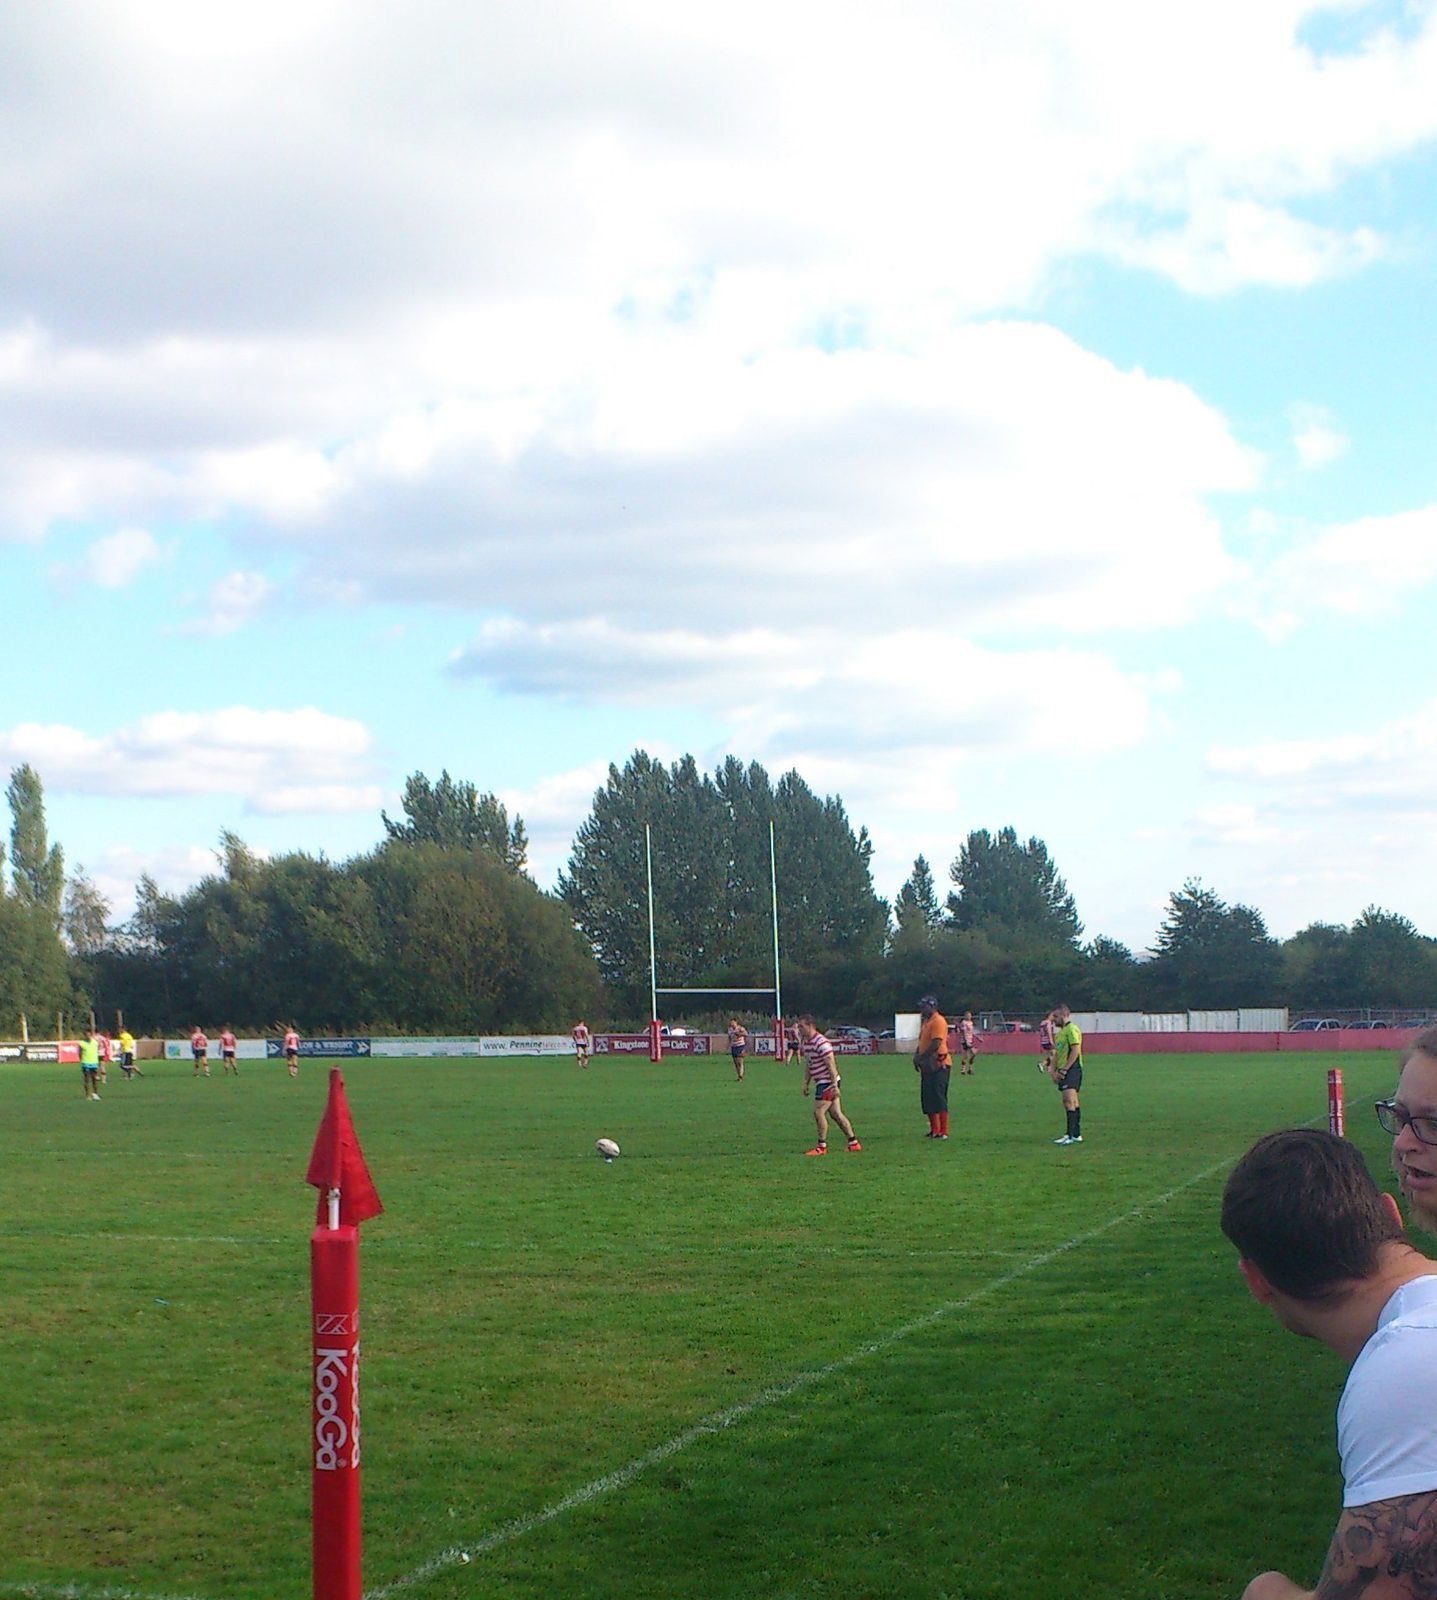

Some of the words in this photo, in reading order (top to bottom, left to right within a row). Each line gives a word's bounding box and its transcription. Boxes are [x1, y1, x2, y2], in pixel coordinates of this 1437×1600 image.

[613, 1040, 649, 1051] Kingstone
[671, 1040, 689, 1049] Cider
[316, 1348, 348, 1470] KooGa
